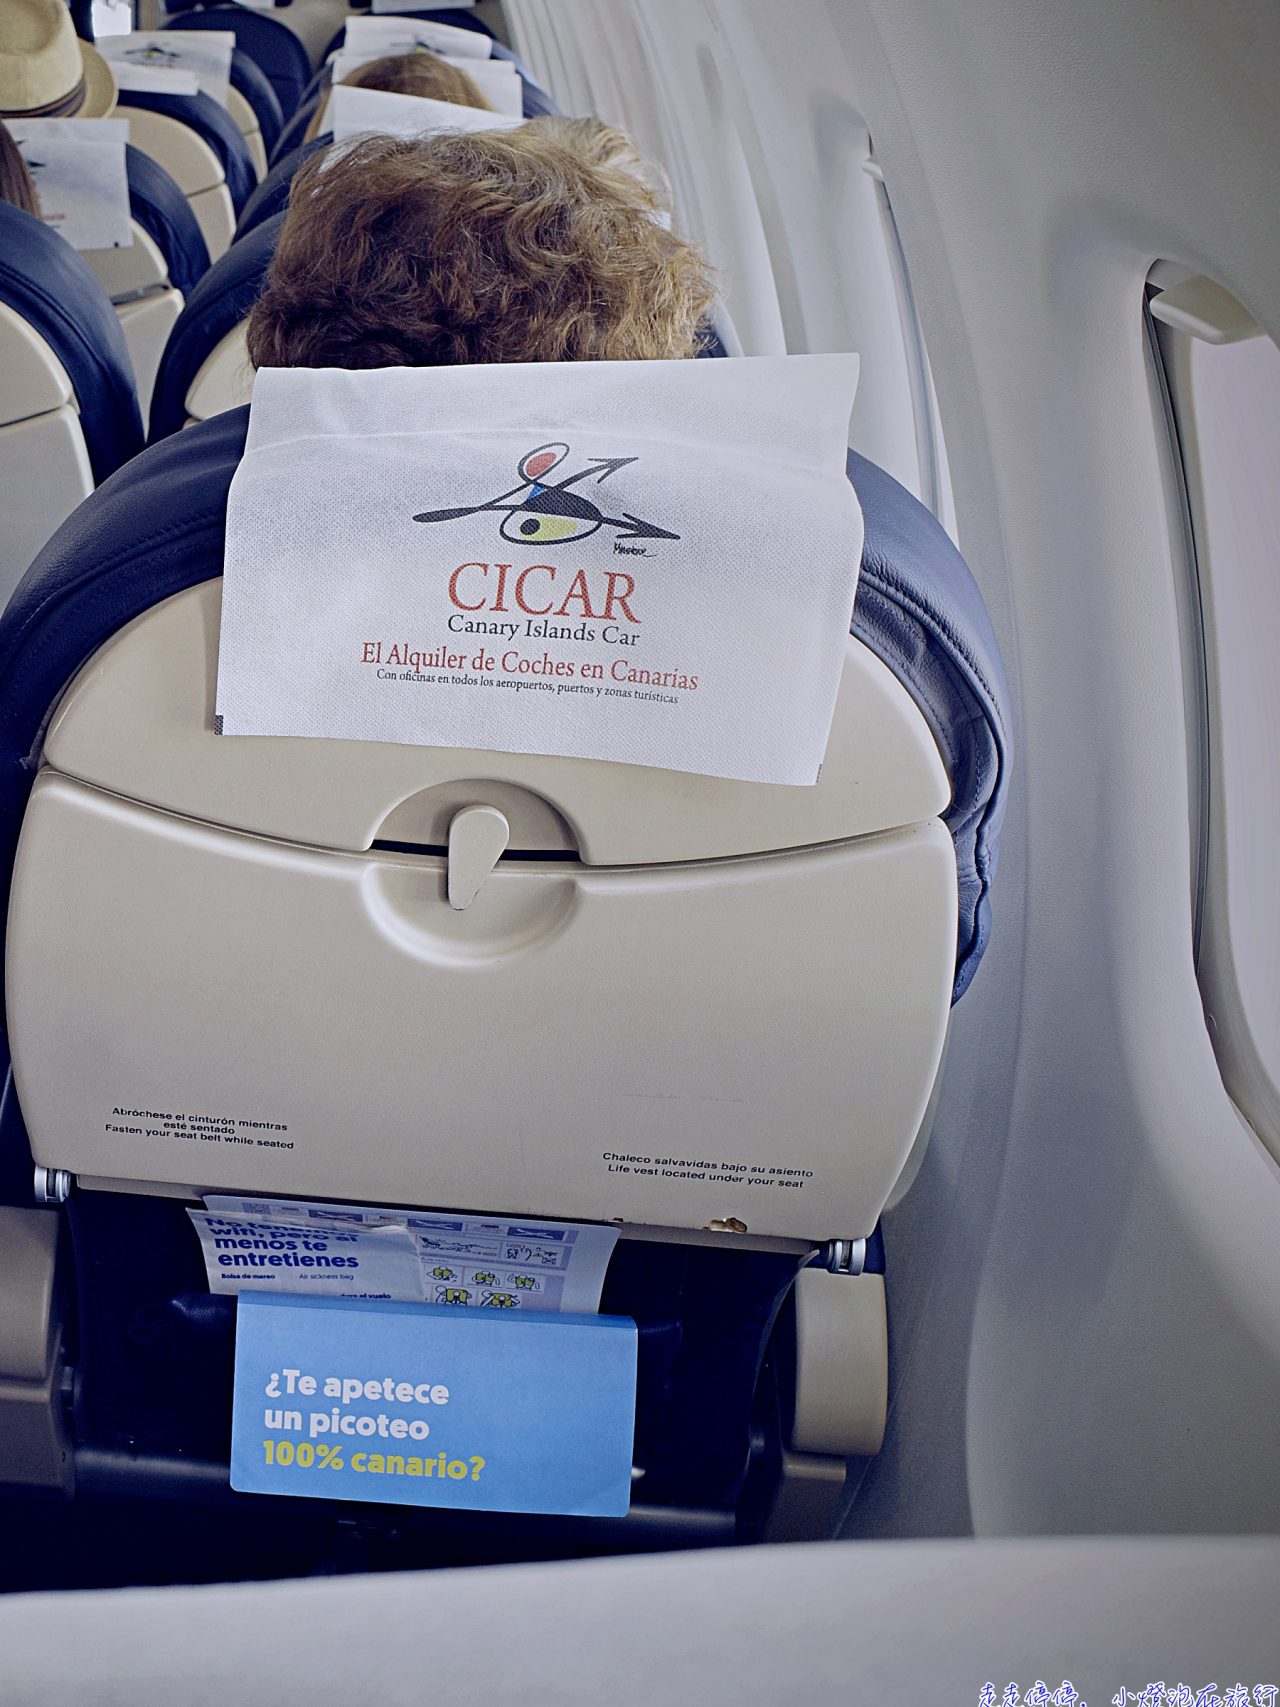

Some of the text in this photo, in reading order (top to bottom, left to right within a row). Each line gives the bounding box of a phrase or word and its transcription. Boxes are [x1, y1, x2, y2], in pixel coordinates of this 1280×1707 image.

[448, 562, 642, 624] CICAR
[447, 614, 641, 648] Canary Islands Car
[361, 642, 699, 691] El Alquiler de Coches en Canarias
[376, 668, 397, 680] Con
[399, 670, 436, 684] oficinas
[438, 675, 450, 684] en
[451, 673, 478, 687] todos
[480, 676, 494, 688] los
[496, 680, 556, 694] aeropuertos,
[558, 683, 594, 697] puertos
[596, 688, 603, 698] y
[604, 687, 632, 698] zonas
[112, 1107, 288, 1132] Abróchese el cinturón mientras
[163, 1121, 236, 1135] esté sentado
[105, 1124, 295, 1149] Fasten your seat belt while seated
[602, 1151, 814, 1178] Chaleco salvavidas bajo su asiento
[608, 1164, 804, 1188] Life vest located under your seat
[204, 1217, 243, 1228] No
[214, 1238, 328, 1252] menos te
[270, 1230, 329, 1242] pero
[218, 1252, 360, 1268] entretienes
[264, 1368, 450, 1405] ¿Te apetece
[264, 1407, 430, 1440] un picoteo
[263, 1440, 487, 1482] 100% canario?
